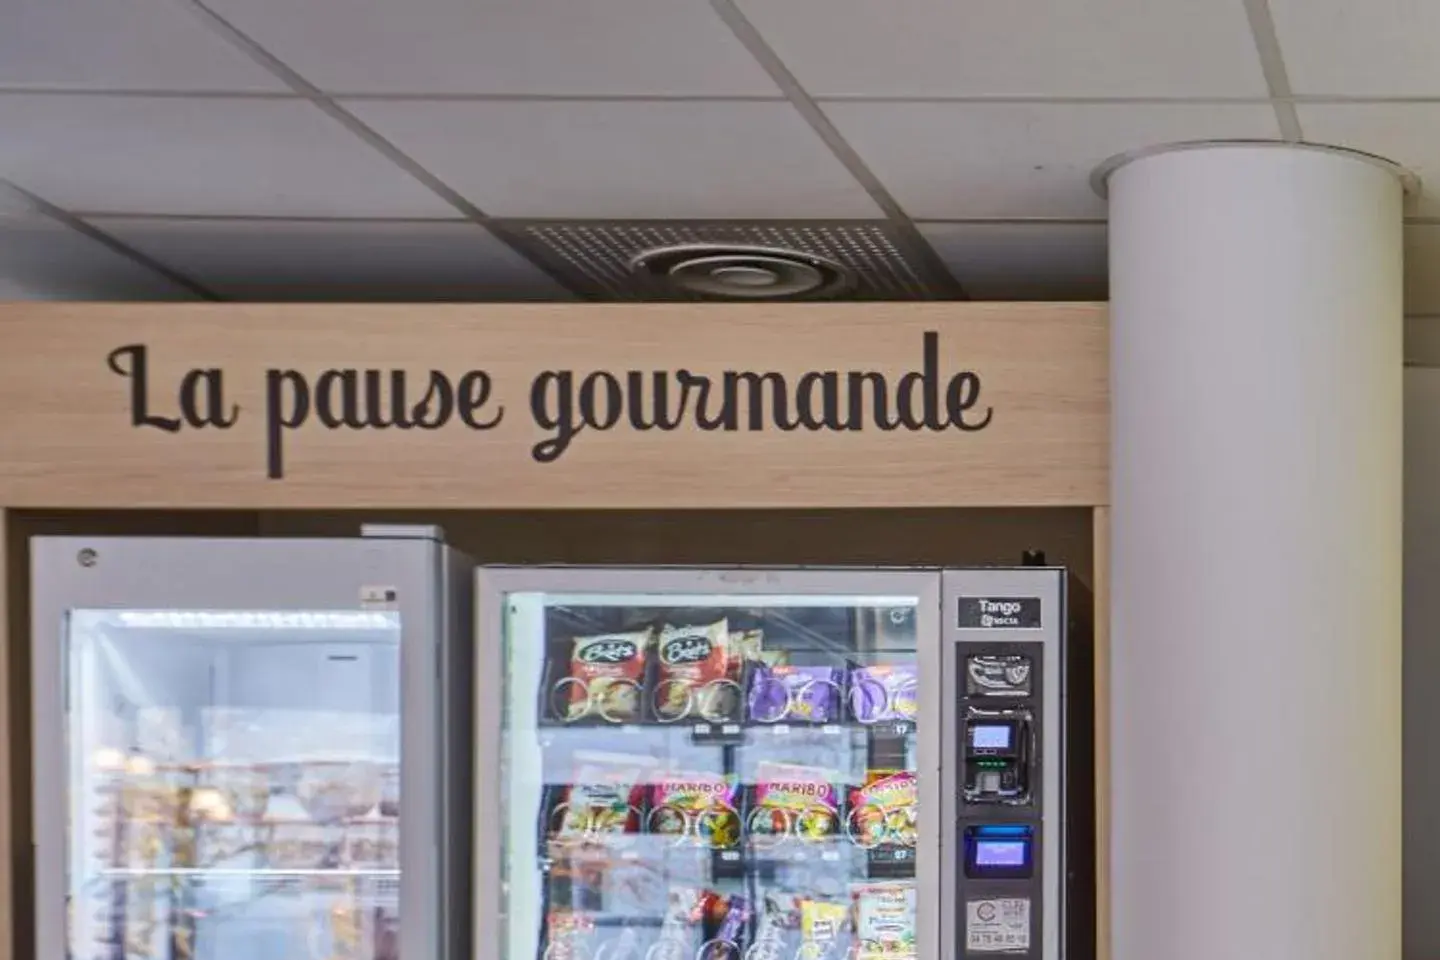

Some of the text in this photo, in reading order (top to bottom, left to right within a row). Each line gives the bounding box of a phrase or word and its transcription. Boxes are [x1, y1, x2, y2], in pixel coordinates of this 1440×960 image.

[106, 331, 994, 479] La pause gourmande
[979, 599, 1021, 615] Tango
